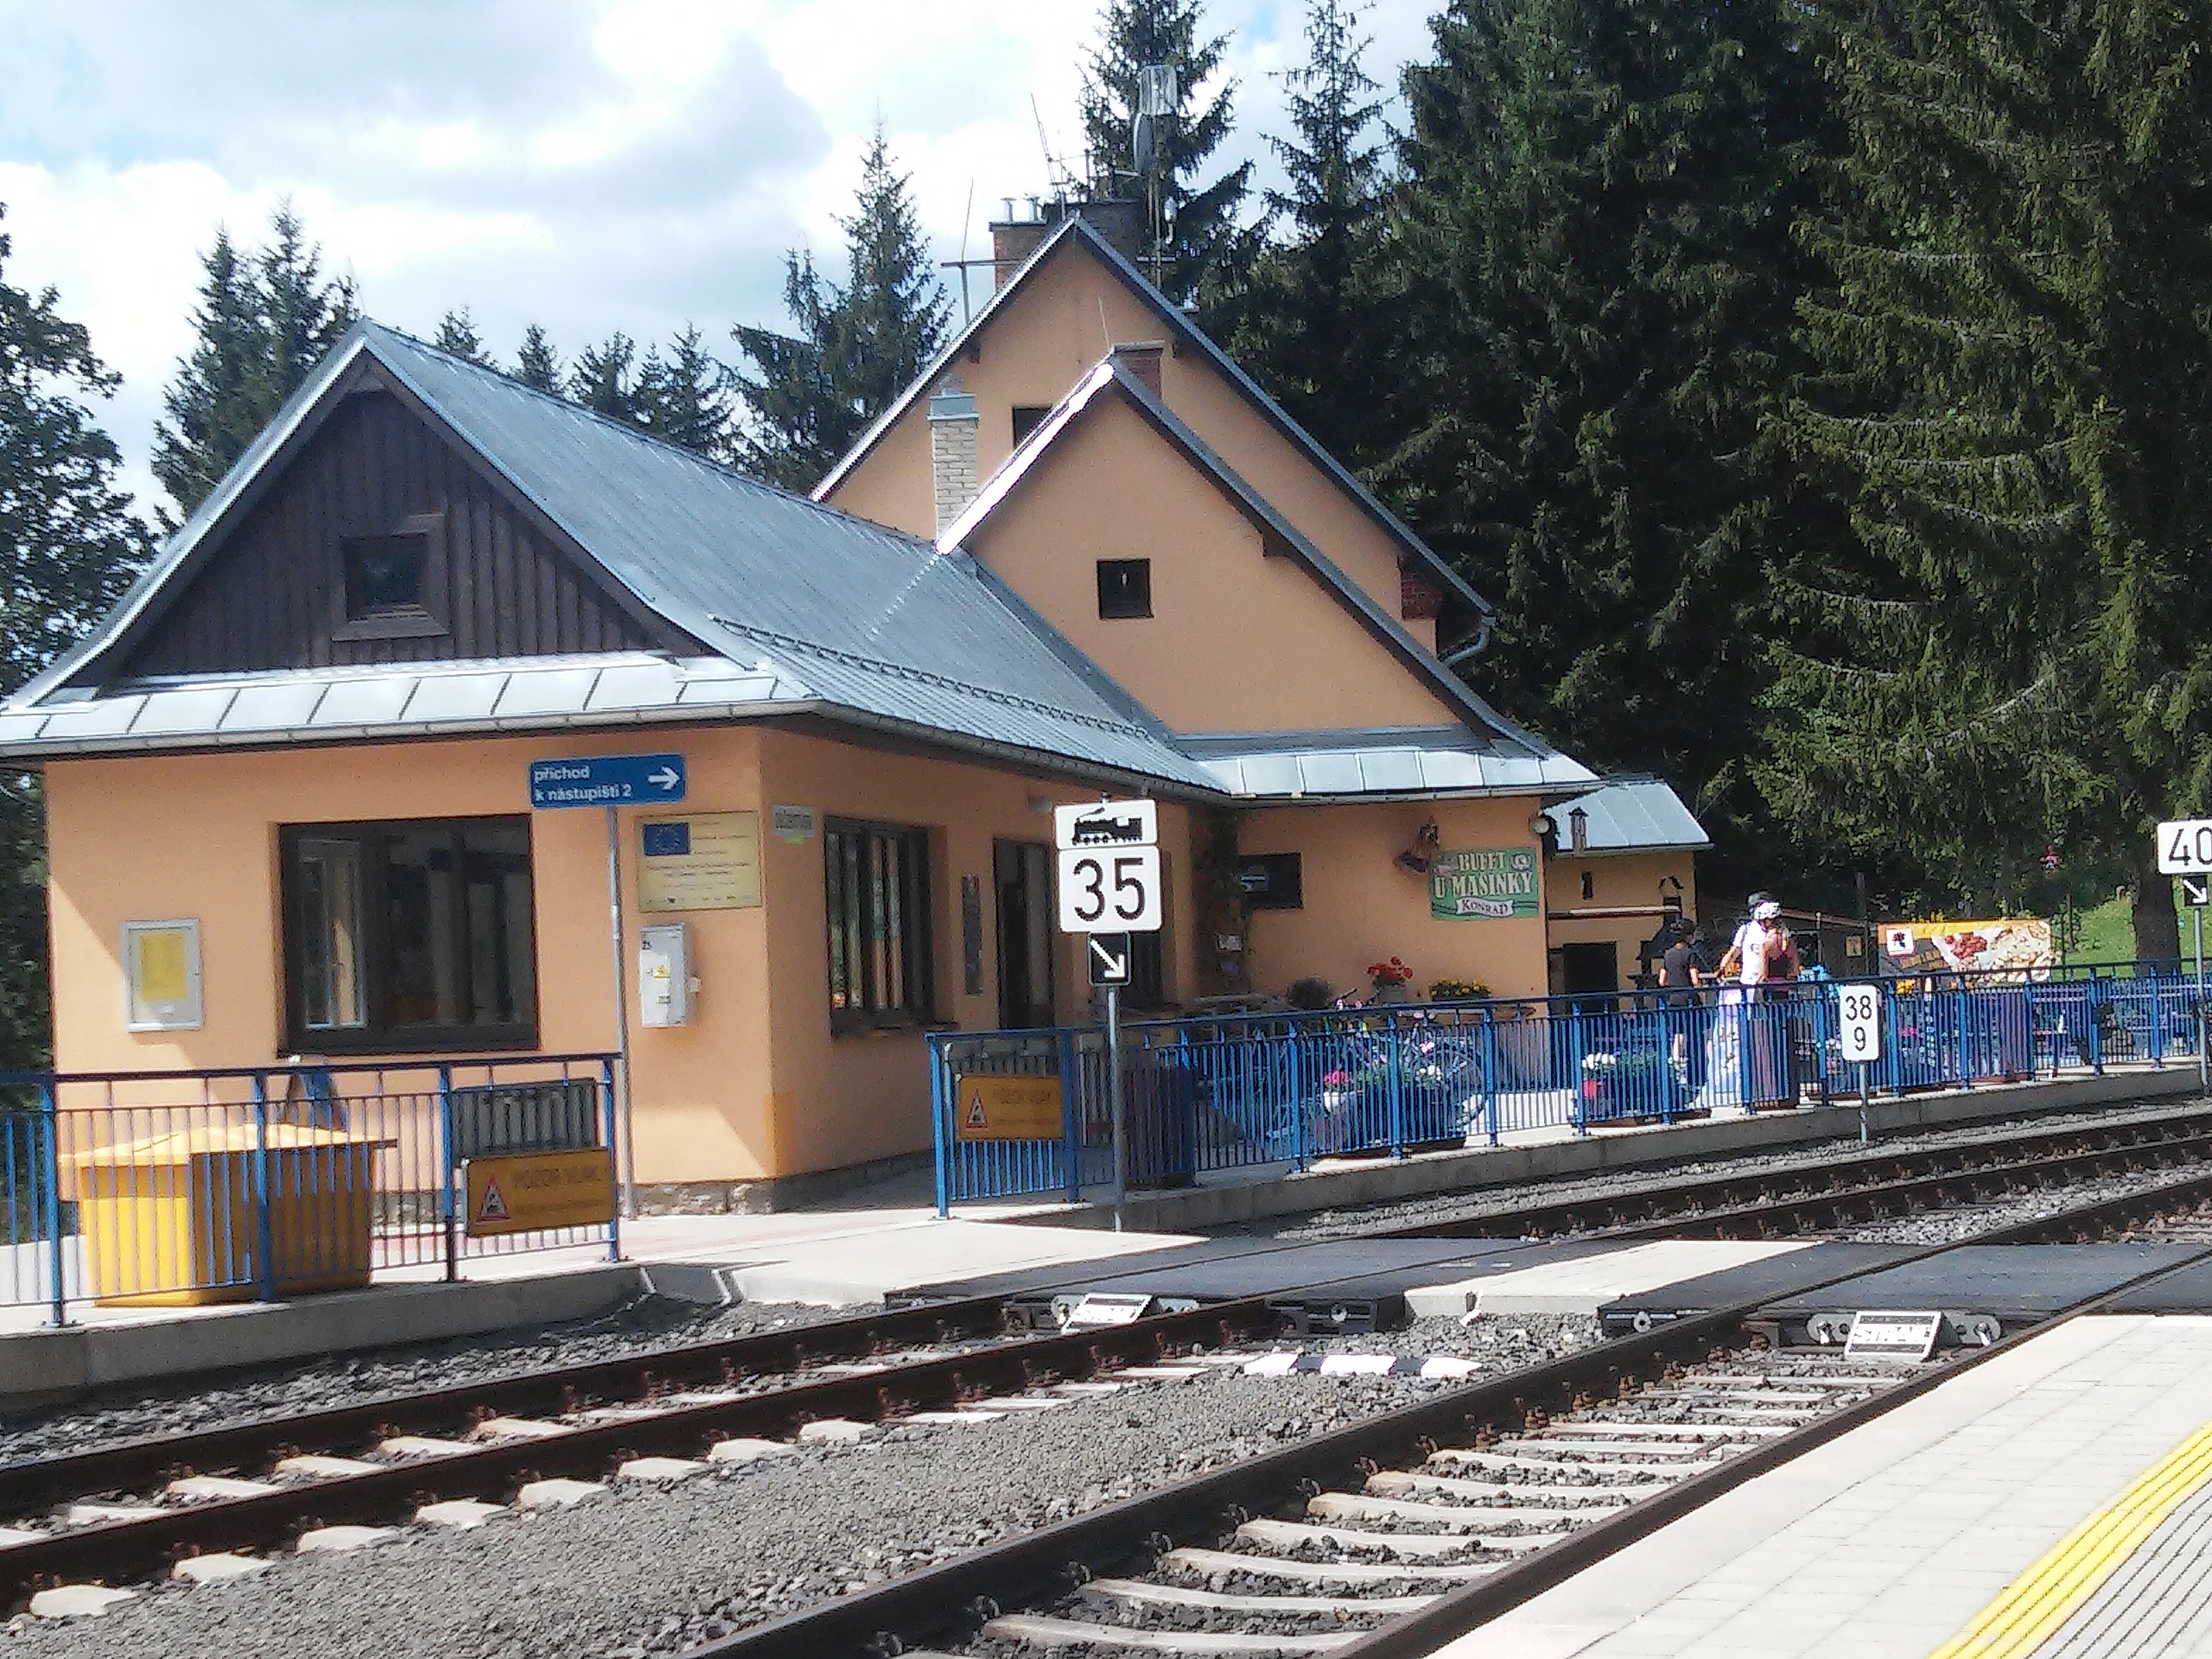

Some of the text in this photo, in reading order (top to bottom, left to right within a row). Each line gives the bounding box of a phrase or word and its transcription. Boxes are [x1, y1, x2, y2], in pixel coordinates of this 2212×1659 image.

[535, 789, 545, 801] k
[622, 783, 631, 797] 2
[2168, 826, 2212, 866] 40
[1073, 858, 1145, 921] 35
[1434, 877, 1446, 898] U
[1845, 995, 1873, 1021] 38
[1854, 1026, 1867, 1051] 9
